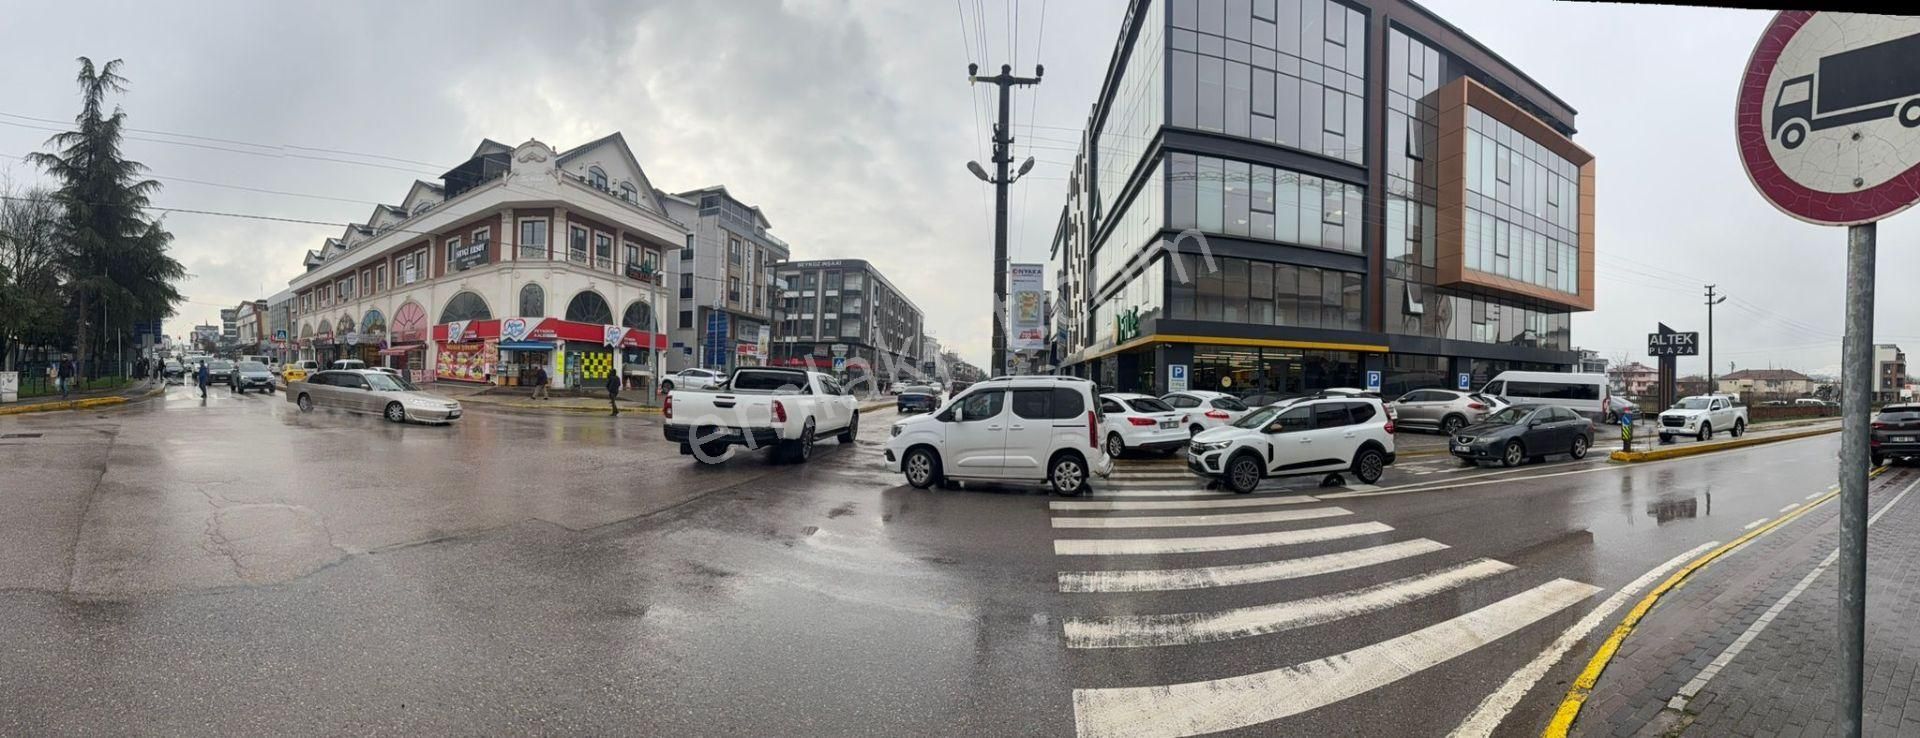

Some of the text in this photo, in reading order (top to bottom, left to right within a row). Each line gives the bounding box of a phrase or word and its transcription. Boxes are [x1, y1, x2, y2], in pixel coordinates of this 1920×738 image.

[1650, 333, 1693, 345] ALTEK
[1649, 346, 1694, 354] PLAZA
[1175, 367, 1183, 377] P
[1370, 374, 1378, 385] P
[1461, 375, 1468, 385] P
